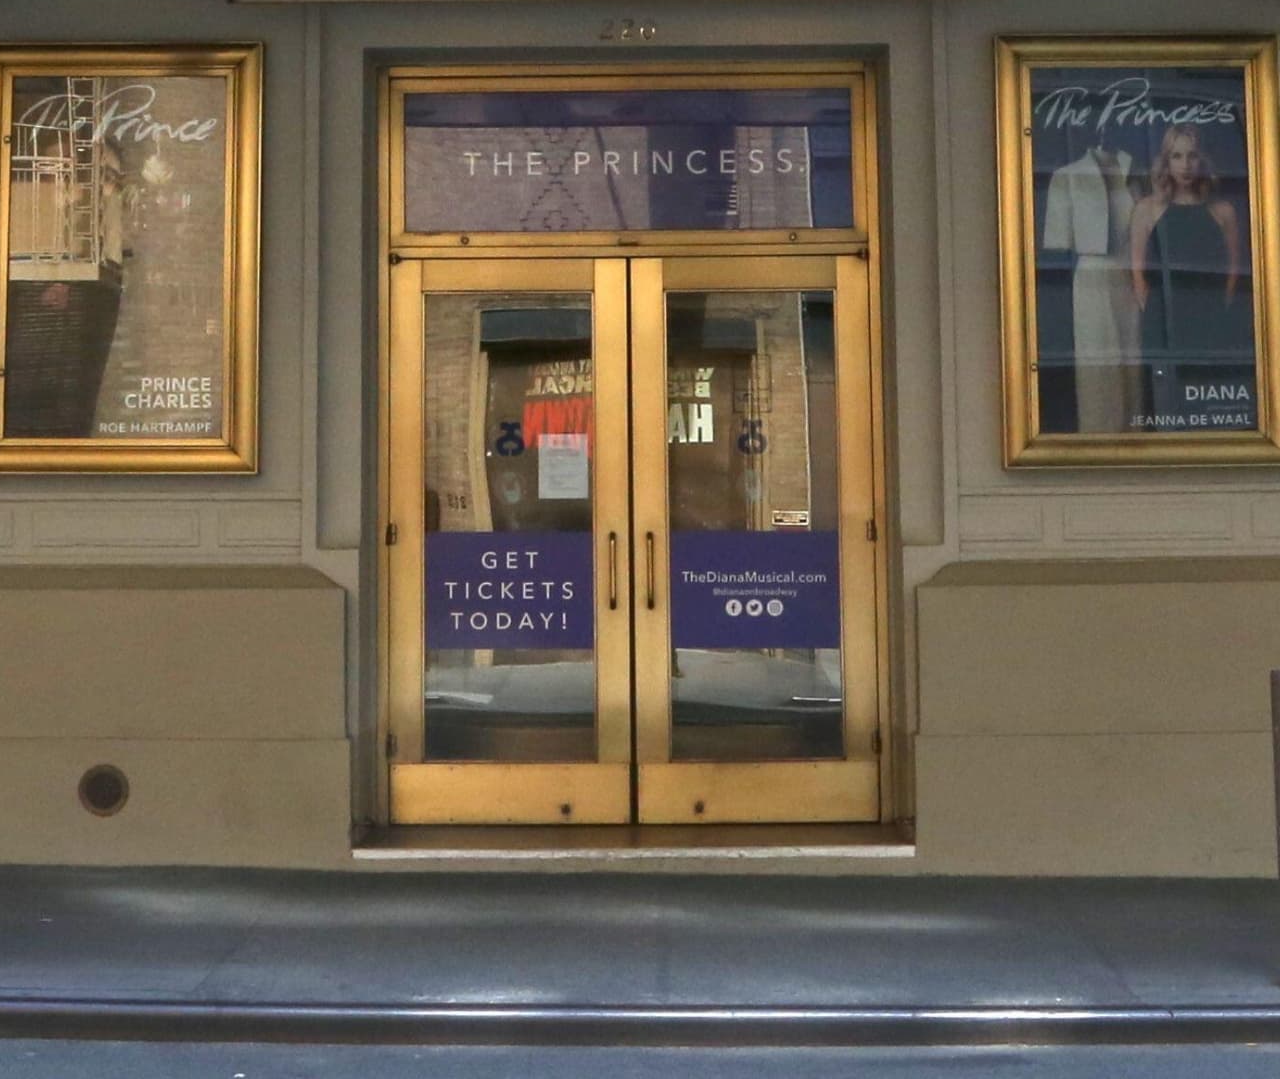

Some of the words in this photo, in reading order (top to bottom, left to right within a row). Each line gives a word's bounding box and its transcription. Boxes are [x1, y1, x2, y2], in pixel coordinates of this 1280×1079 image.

[1035, 87, 1091, 128] The
[1096, 77, 1236, 131] Princess
[20, 93, 86, 144] The
[92, 84, 216, 143] Prince
[463, 151, 543, 177] THE
[573, 148, 806, 176] PRINCESS.
[141, 377, 211, 392] PRINCE
[1185, 384, 1250, 401] DIANA
[124, 393, 212, 409] CHARLES
[99, 422, 126, 433] ROE
[130, 421, 211, 433] HARTRAMPF
[1129, 415, 1186, 426] JEANNA
[1190, 414, 1207, 425] DE
[1211, 413, 1251, 425] WAAL
[481, 551, 539, 569] GET
[682, 571, 827, 583] TheDianaMusical.com
[444, 582, 574, 600] TICKETS
[450, 612, 567, 630] TODAY!
